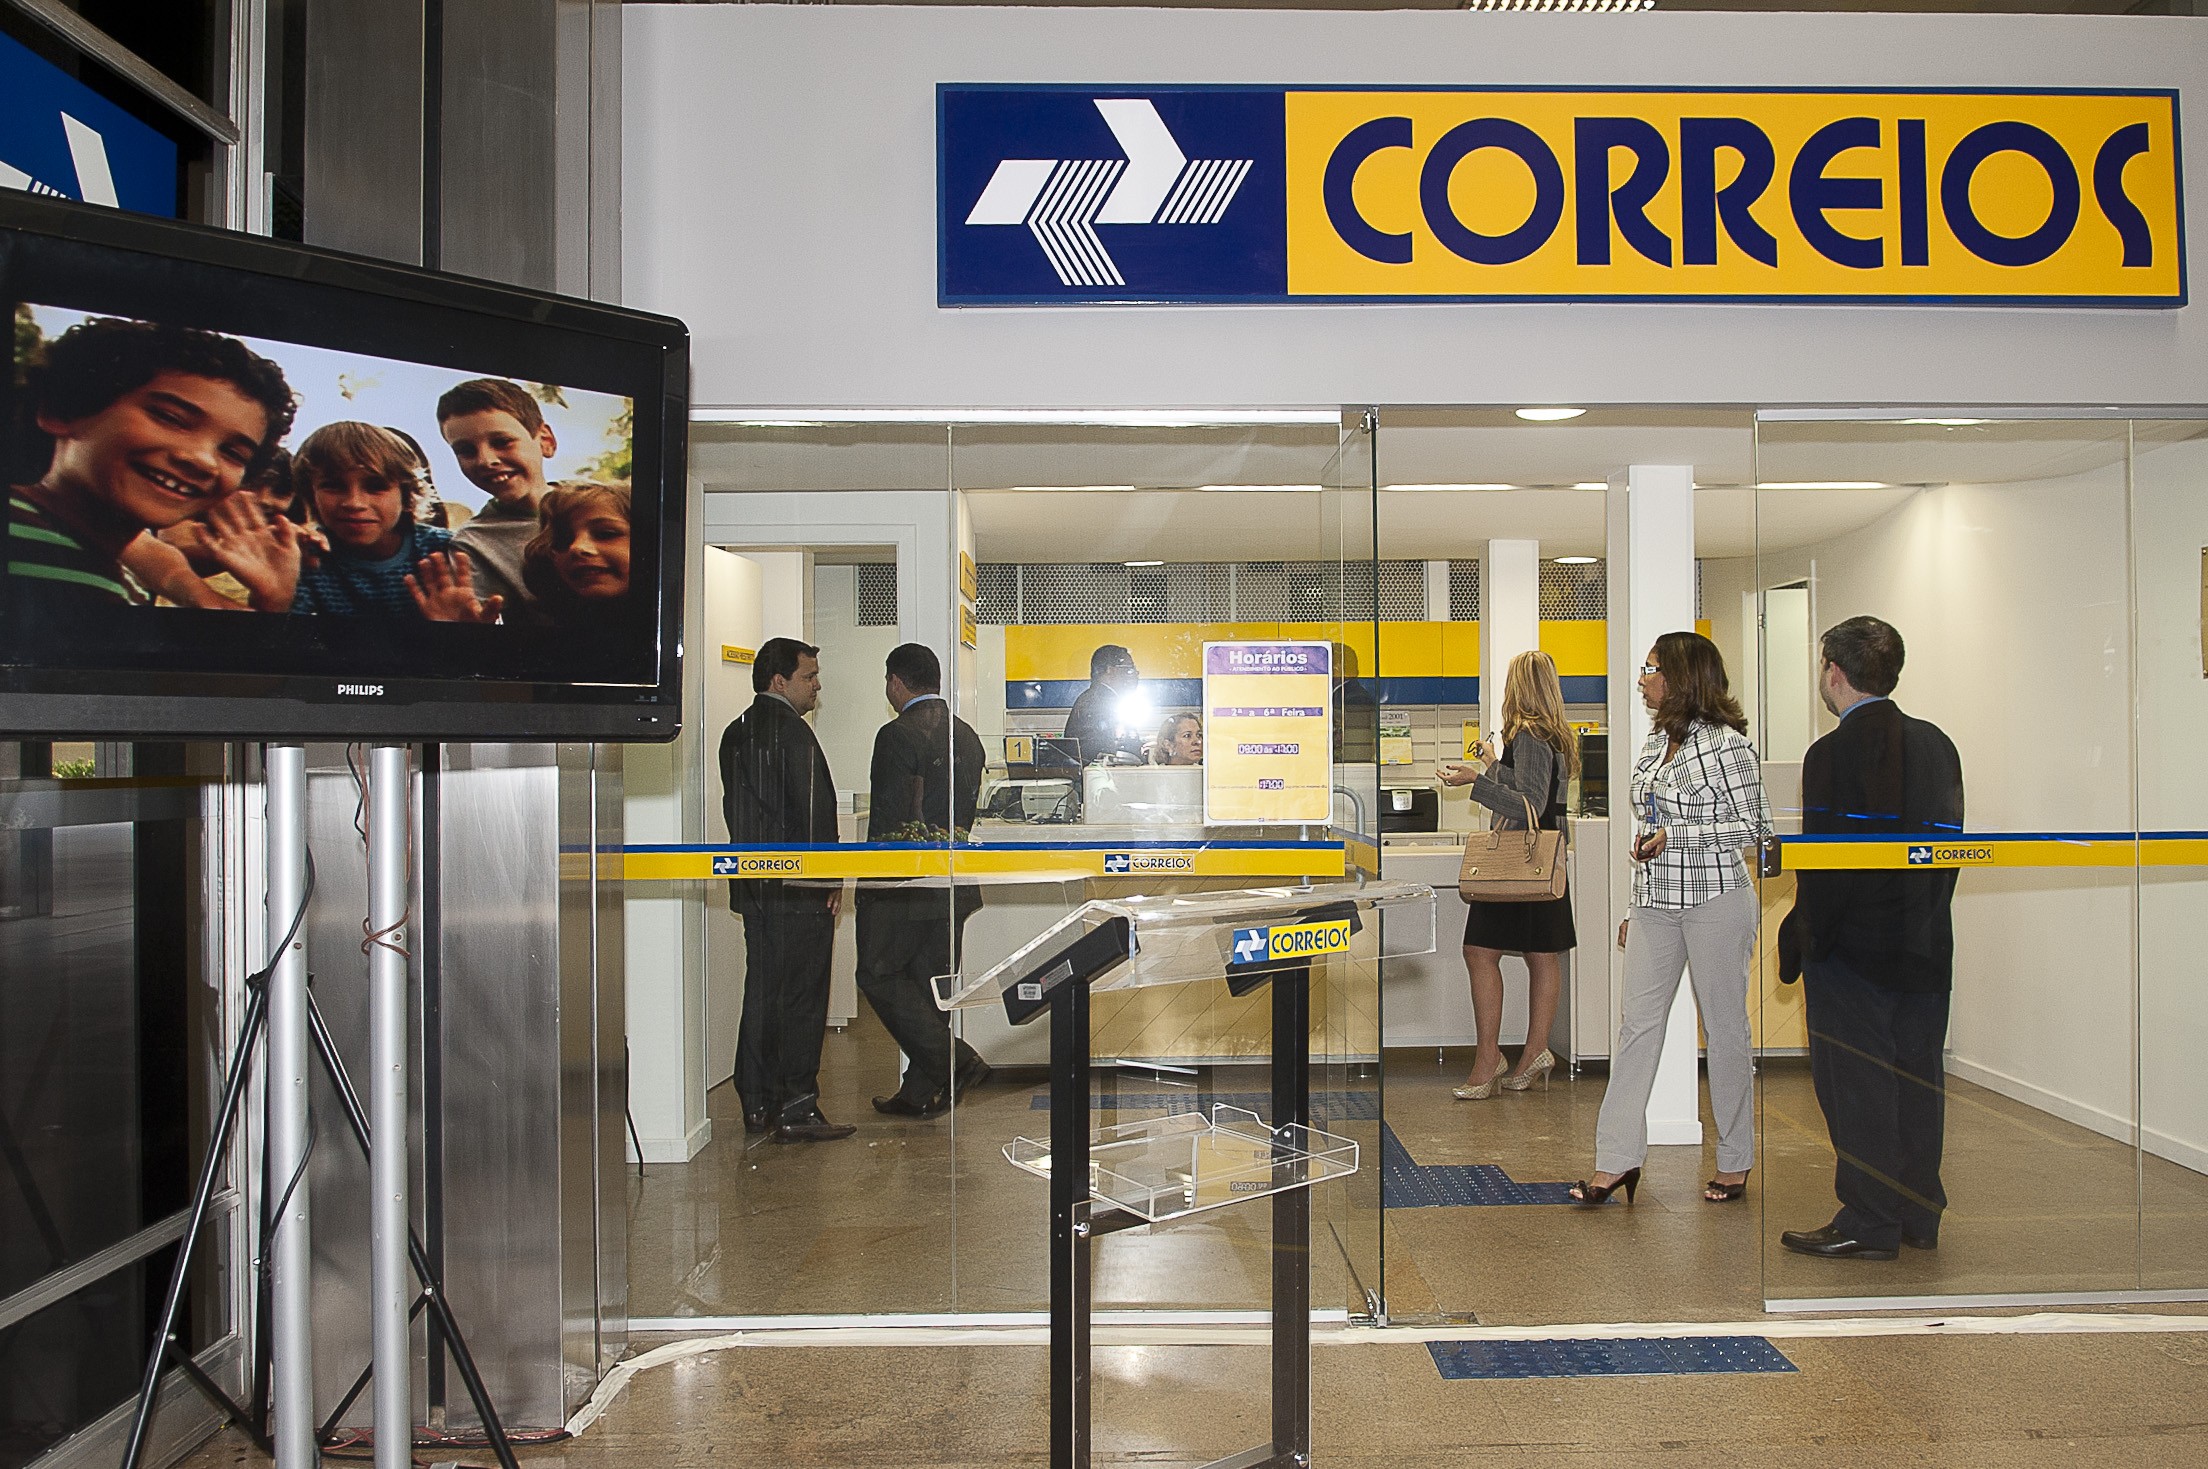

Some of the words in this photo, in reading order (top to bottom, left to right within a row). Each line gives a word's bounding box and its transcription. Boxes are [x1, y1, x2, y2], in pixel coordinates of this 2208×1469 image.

[1321, 115, 2152, 268] CORREIOS
[1229, 650, 1308, 665] Horários
[337, 684, 384, 696] PHILIPS
[1281, 708, 1305, 717] Feira
[1014, 741, 1021, 758] 1
[1935, 848, 1991, 860] CORREIOS
[741, 859, 800, 871] CORREIOS
[1133, 857, 1191, 868] CORREIOS
[1271, 926, 1348, 954] CORREIOS
